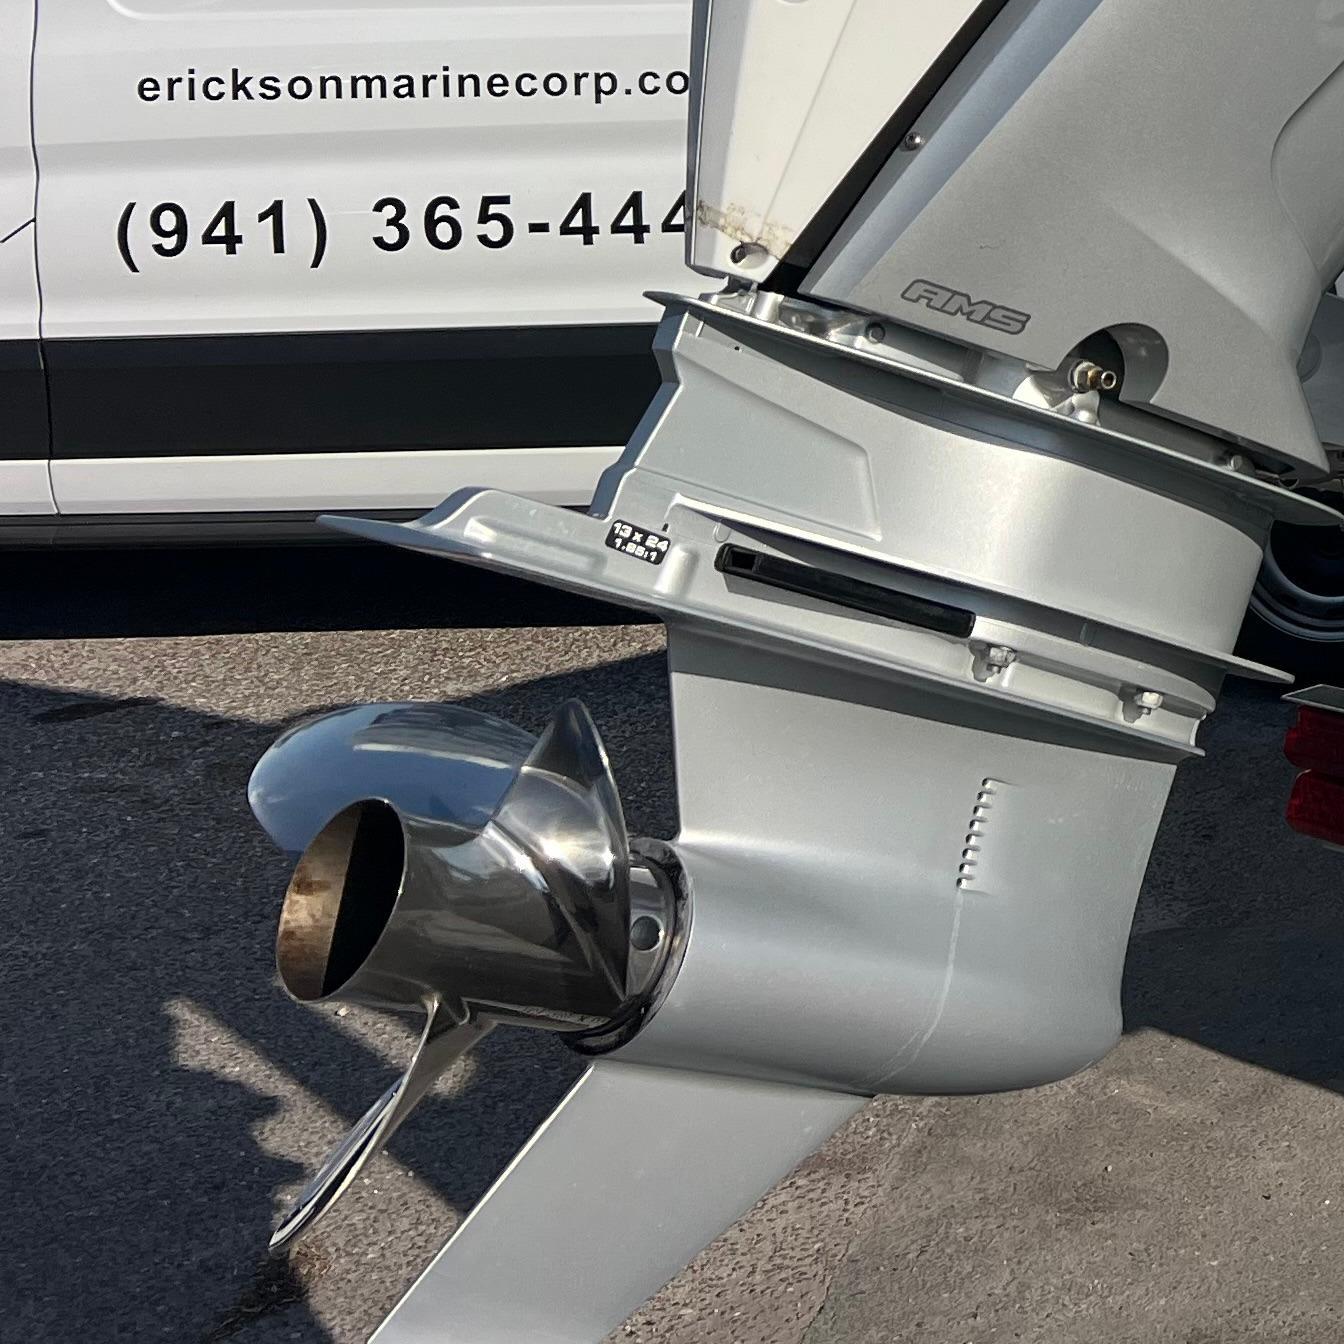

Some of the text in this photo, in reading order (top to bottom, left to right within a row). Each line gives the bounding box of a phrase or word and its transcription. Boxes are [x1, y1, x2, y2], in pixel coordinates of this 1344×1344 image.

[137, 65, 689, 103] ericksonmarinecorp.co
[116, 191, 687, 273] (941) 365-444
[903, 279, 1031, 336] AMS
[613, 522, 632, 538] 13
[645, 534, 669, 552] 24
